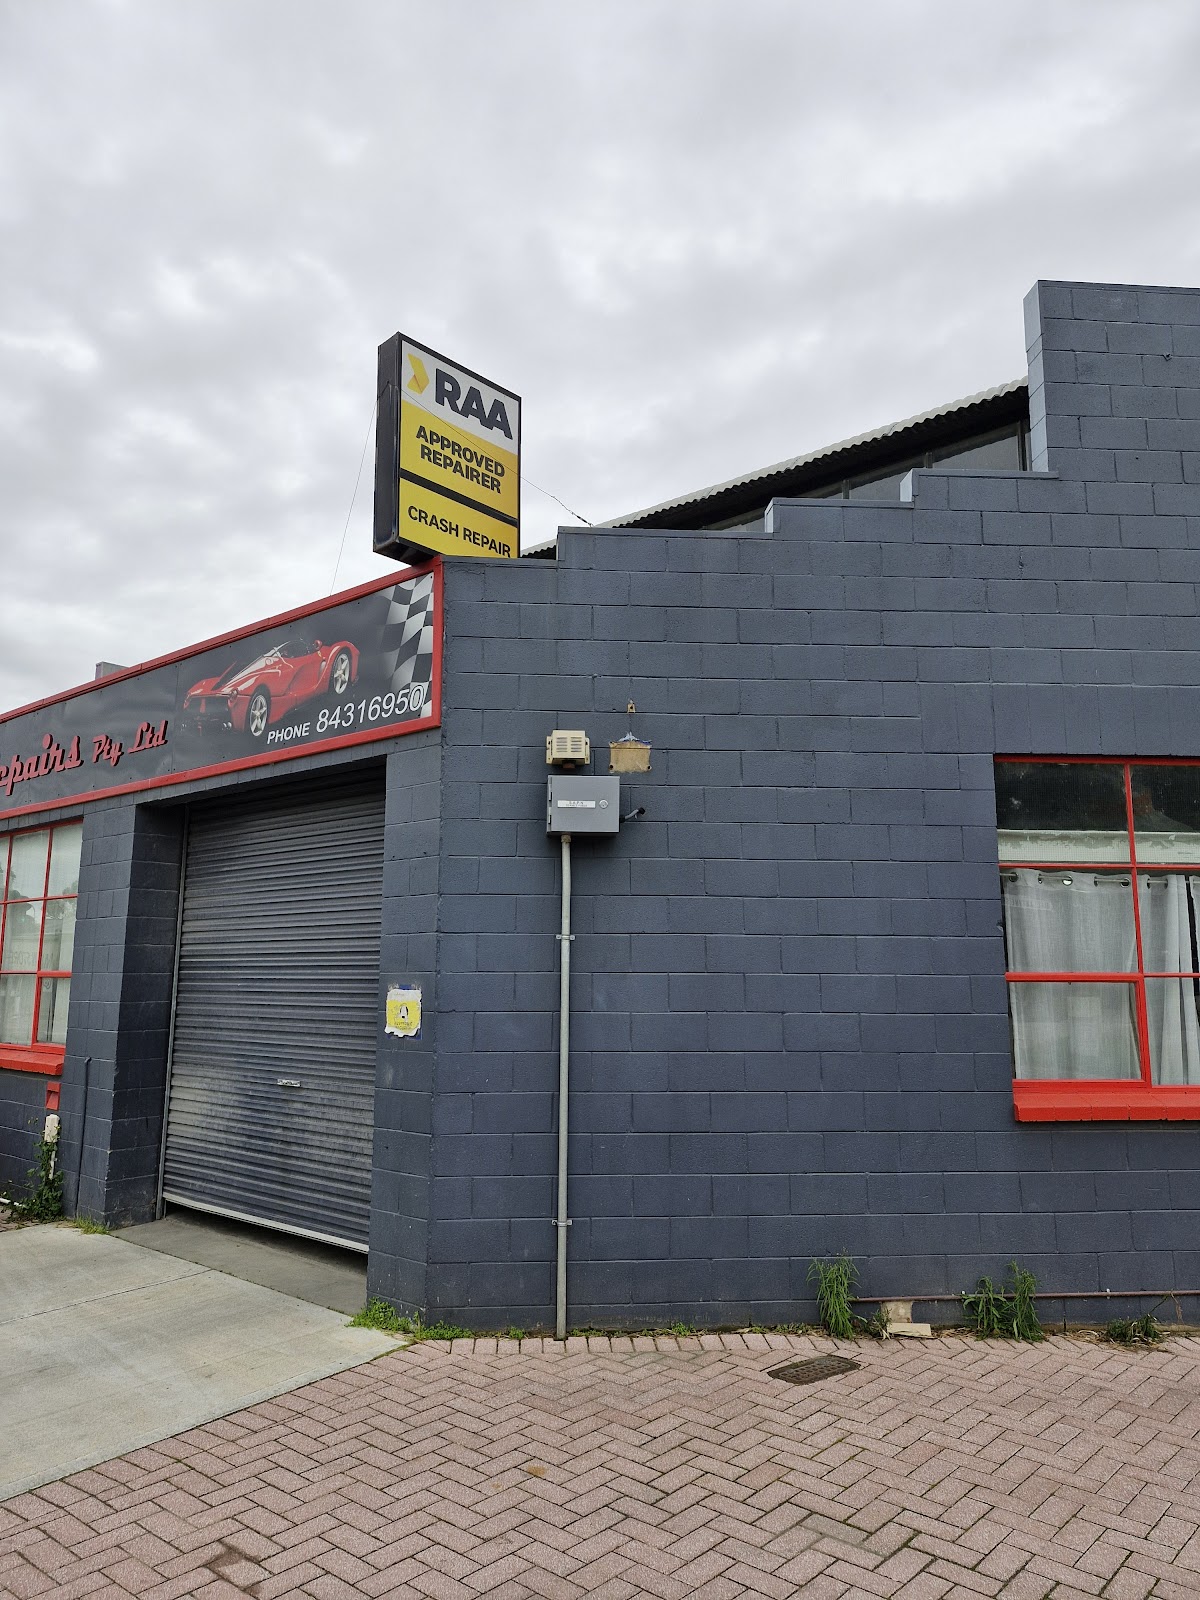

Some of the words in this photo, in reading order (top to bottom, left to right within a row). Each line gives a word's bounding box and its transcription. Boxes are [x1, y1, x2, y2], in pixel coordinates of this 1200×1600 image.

[435, 368, 513, 440] RAA
[416, 425, 505, 477] APPROVED
[420, 444, 501, 493] REPAIRER
[407, 505, 459, 537] CRASH
[463, 527, 511, 557] REPAIR
[267, 722, 311, 744] PHONE
[316, 685, 425, 733] 84316950
[92, 734, 125, 768] Pty
[127, 719, 169, 754] Ltd
